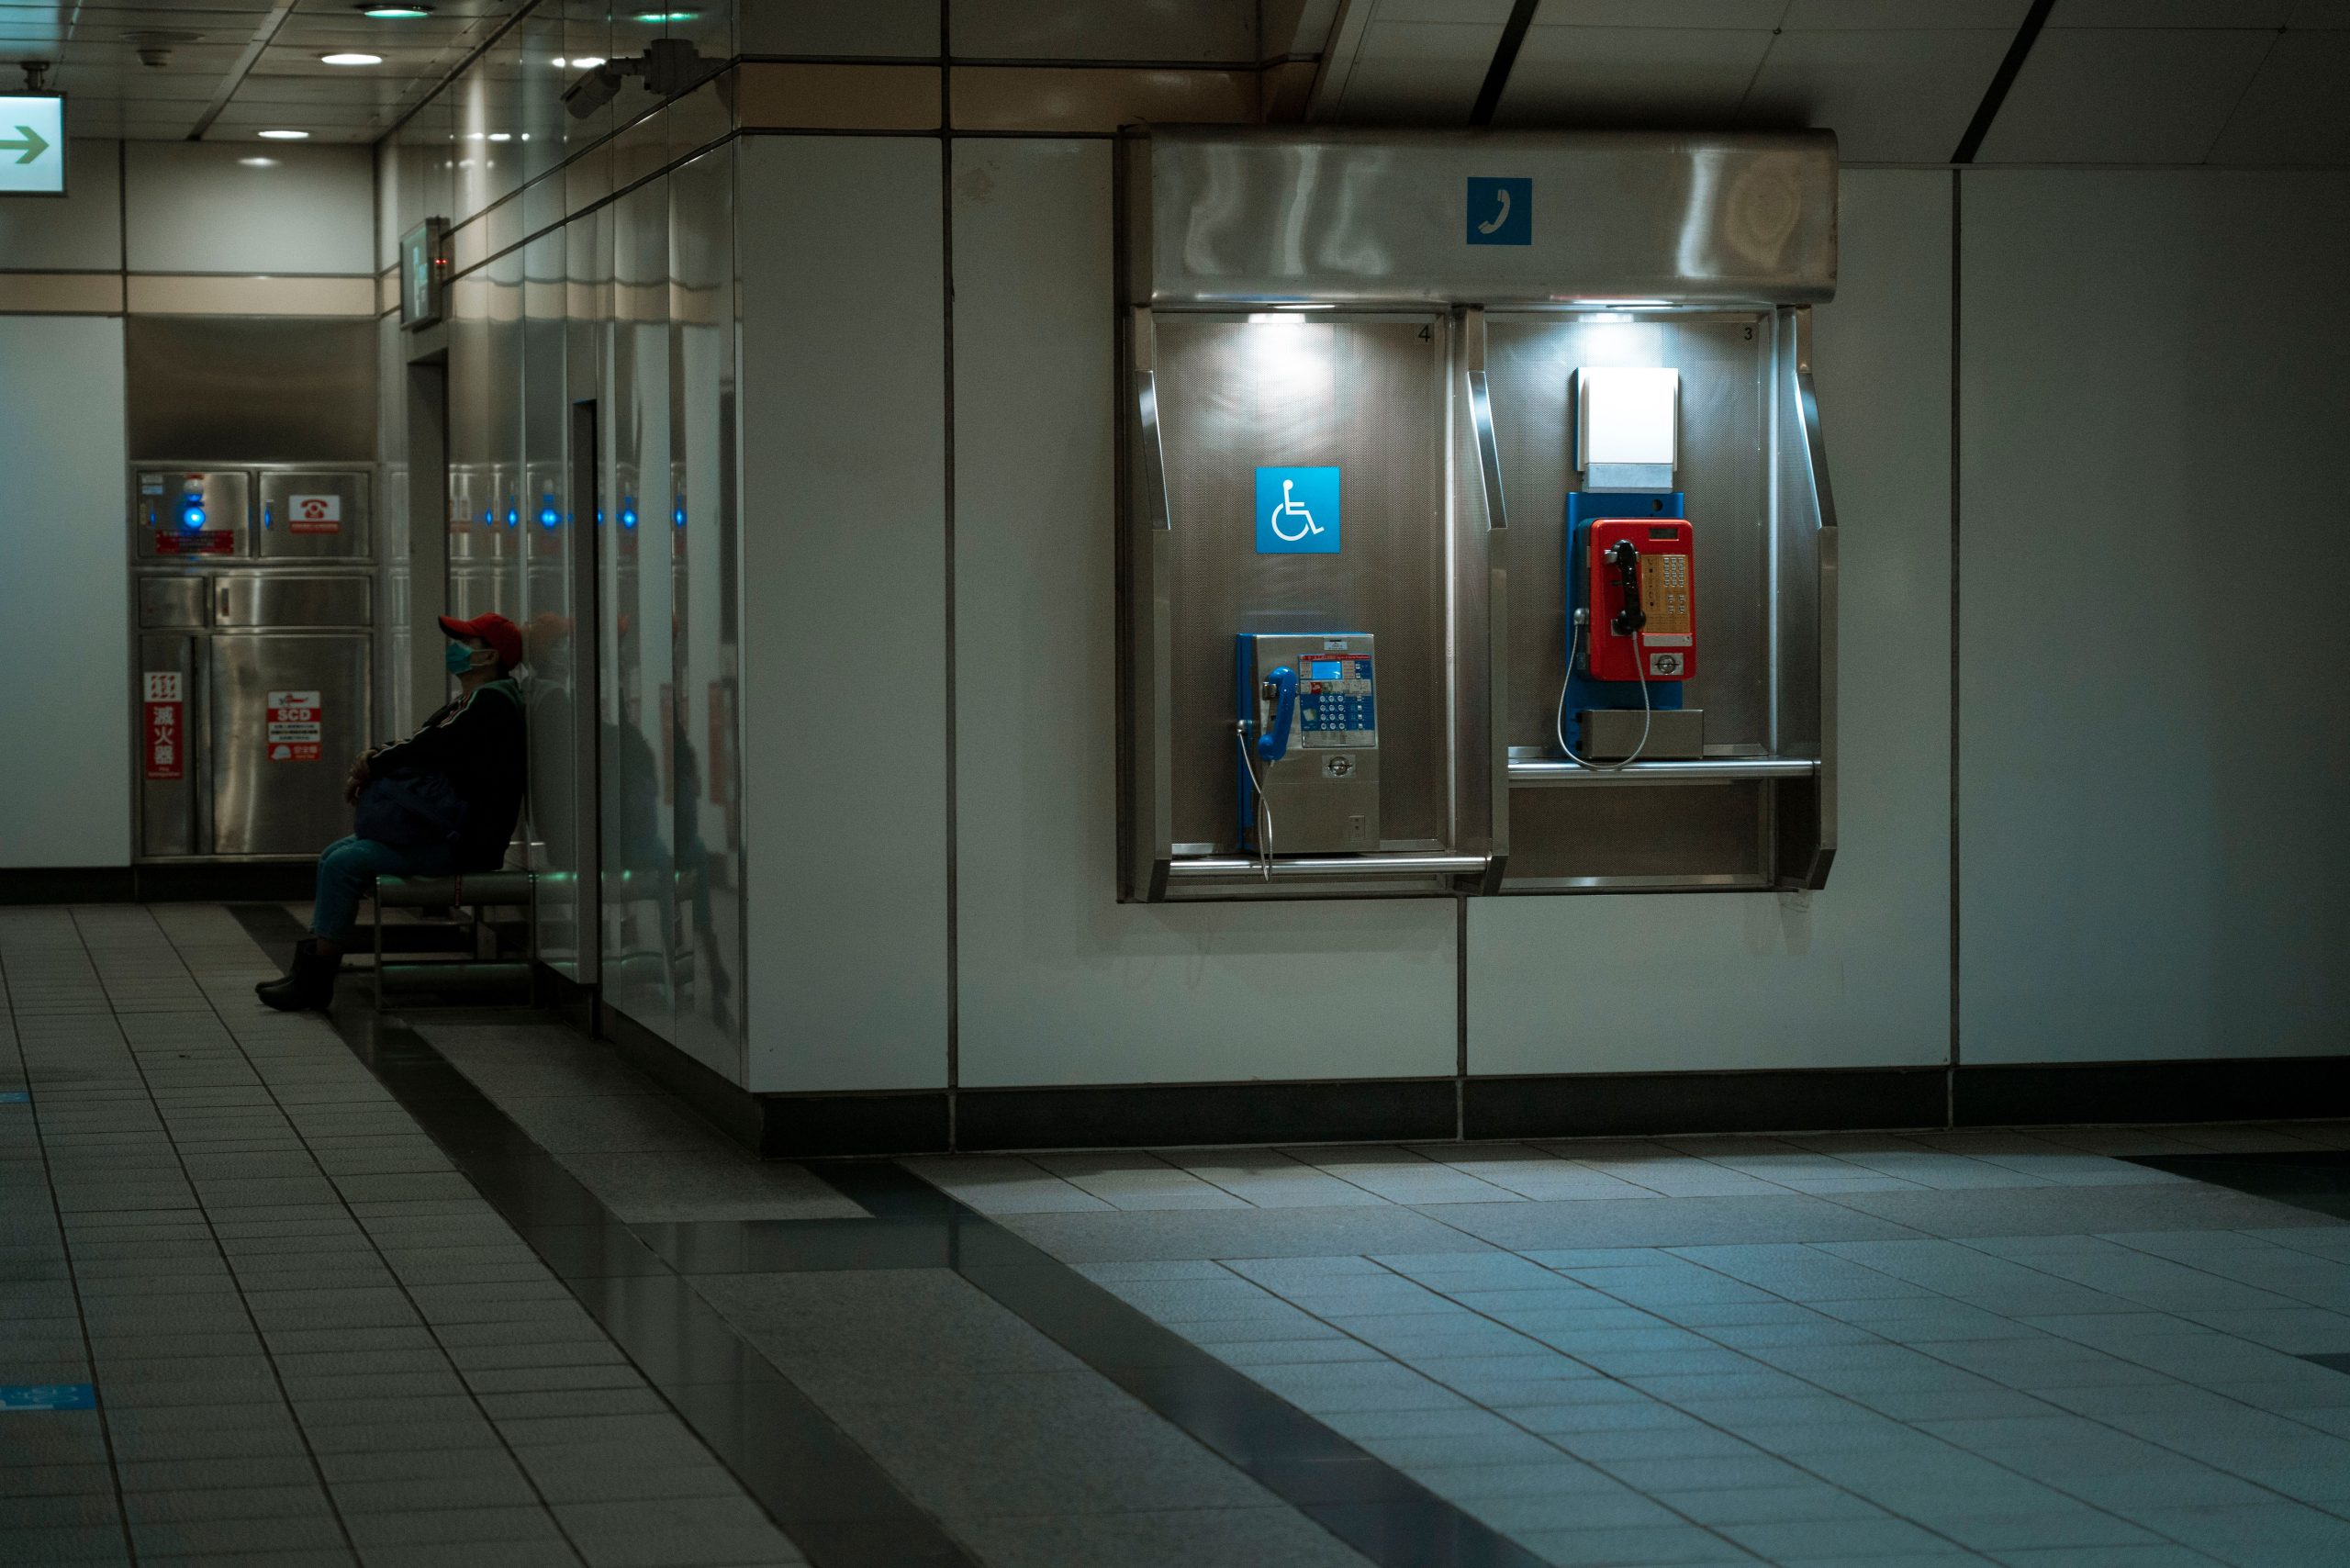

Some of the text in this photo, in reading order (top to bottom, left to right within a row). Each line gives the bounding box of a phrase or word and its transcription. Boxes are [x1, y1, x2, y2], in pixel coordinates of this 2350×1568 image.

[1418, 324, 1431, 342] 4
[1744, 327, 1752, 341] 3
[278, 709, 311, 722] SCD
[152, 705, 175, 765] 滅火器
